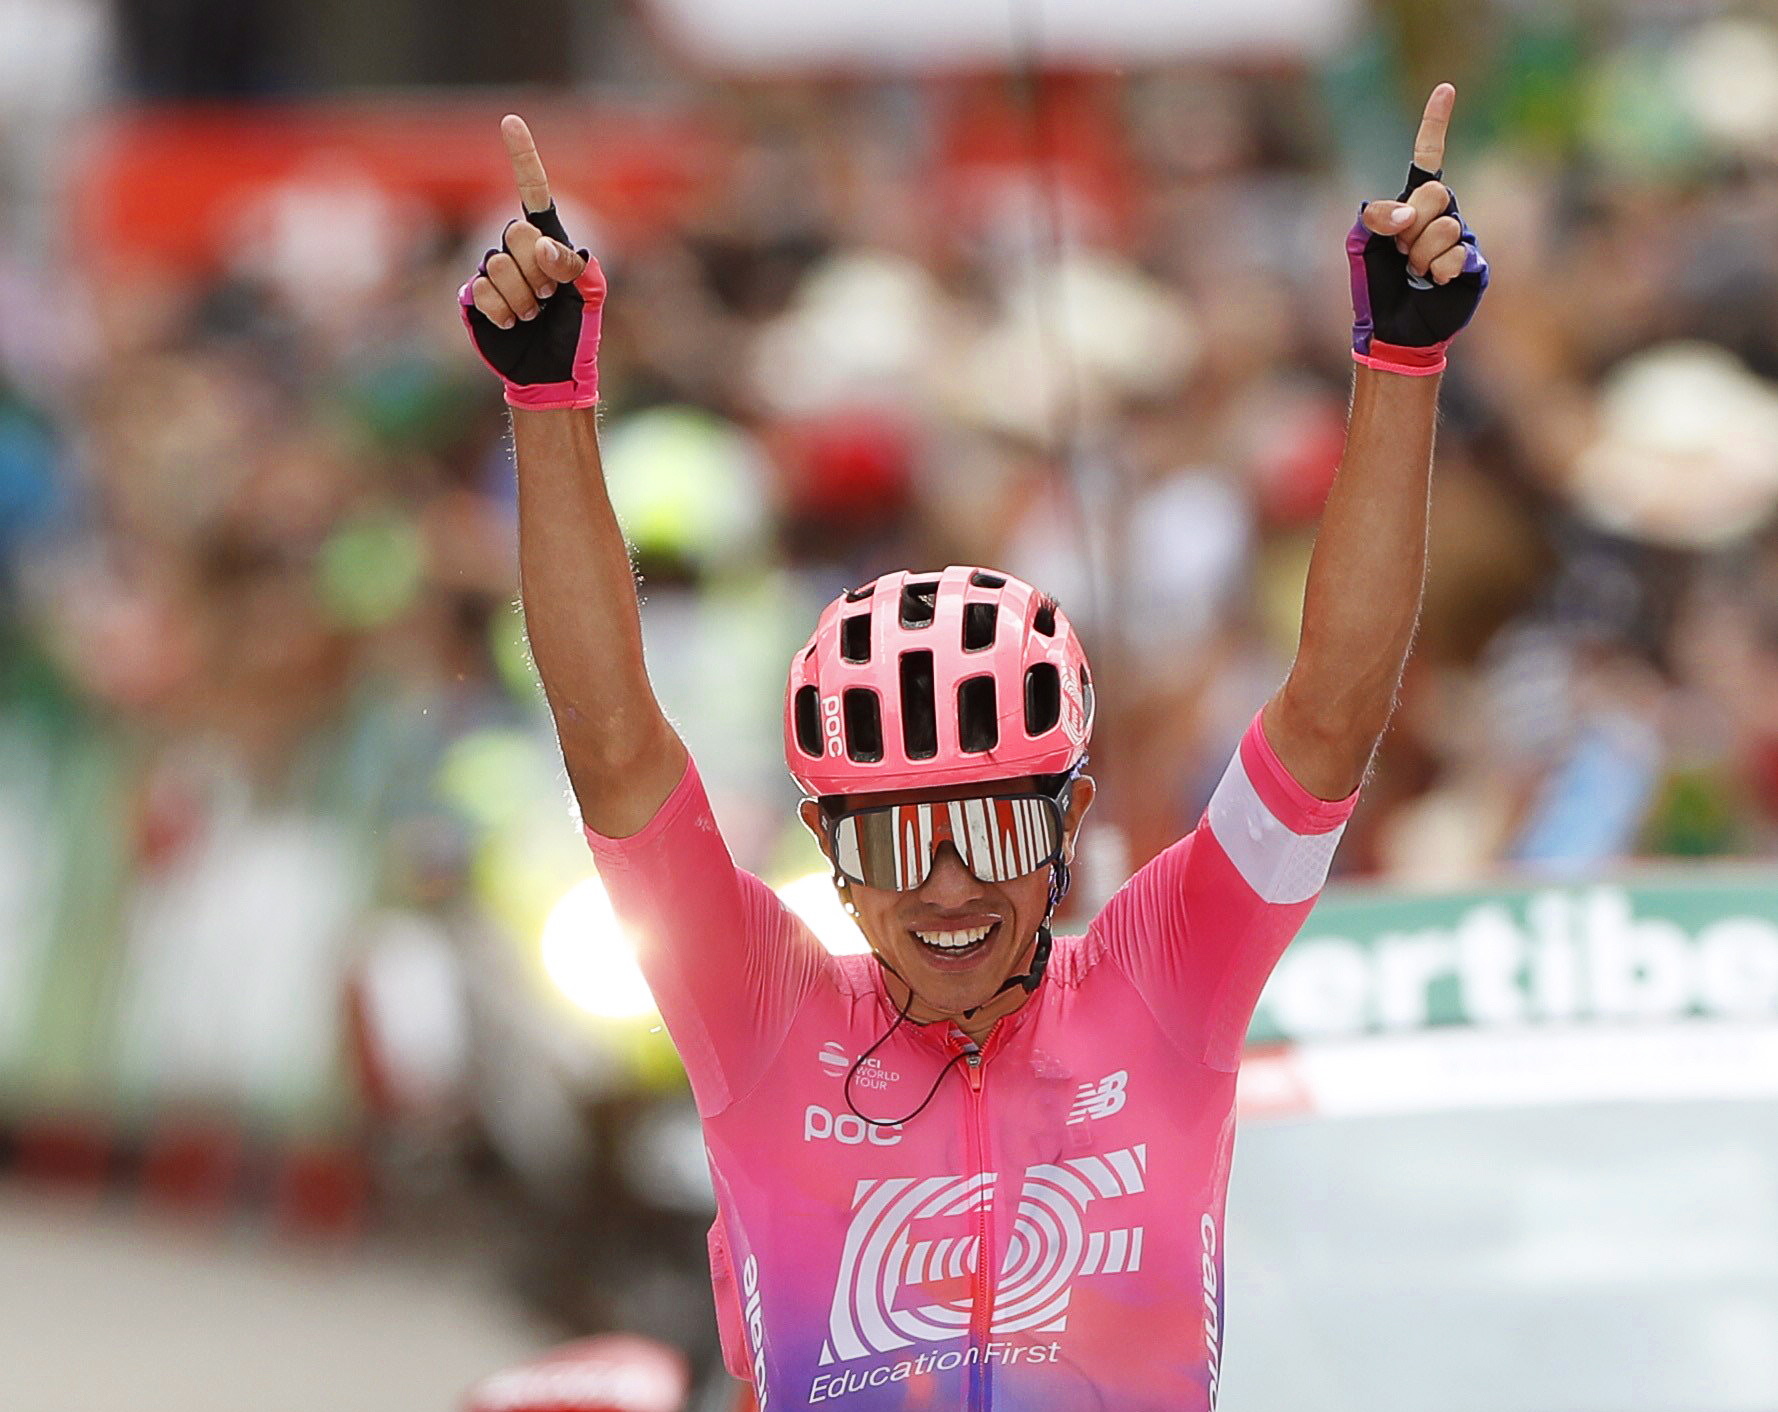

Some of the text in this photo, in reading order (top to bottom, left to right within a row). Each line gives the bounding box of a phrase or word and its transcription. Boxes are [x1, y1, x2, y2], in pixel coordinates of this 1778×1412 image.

[855, 1074, 888, 1090] TOUR
[856, 1066, 900, 1082] WORLD
[808, 1341, 1061, 1404] Education First
